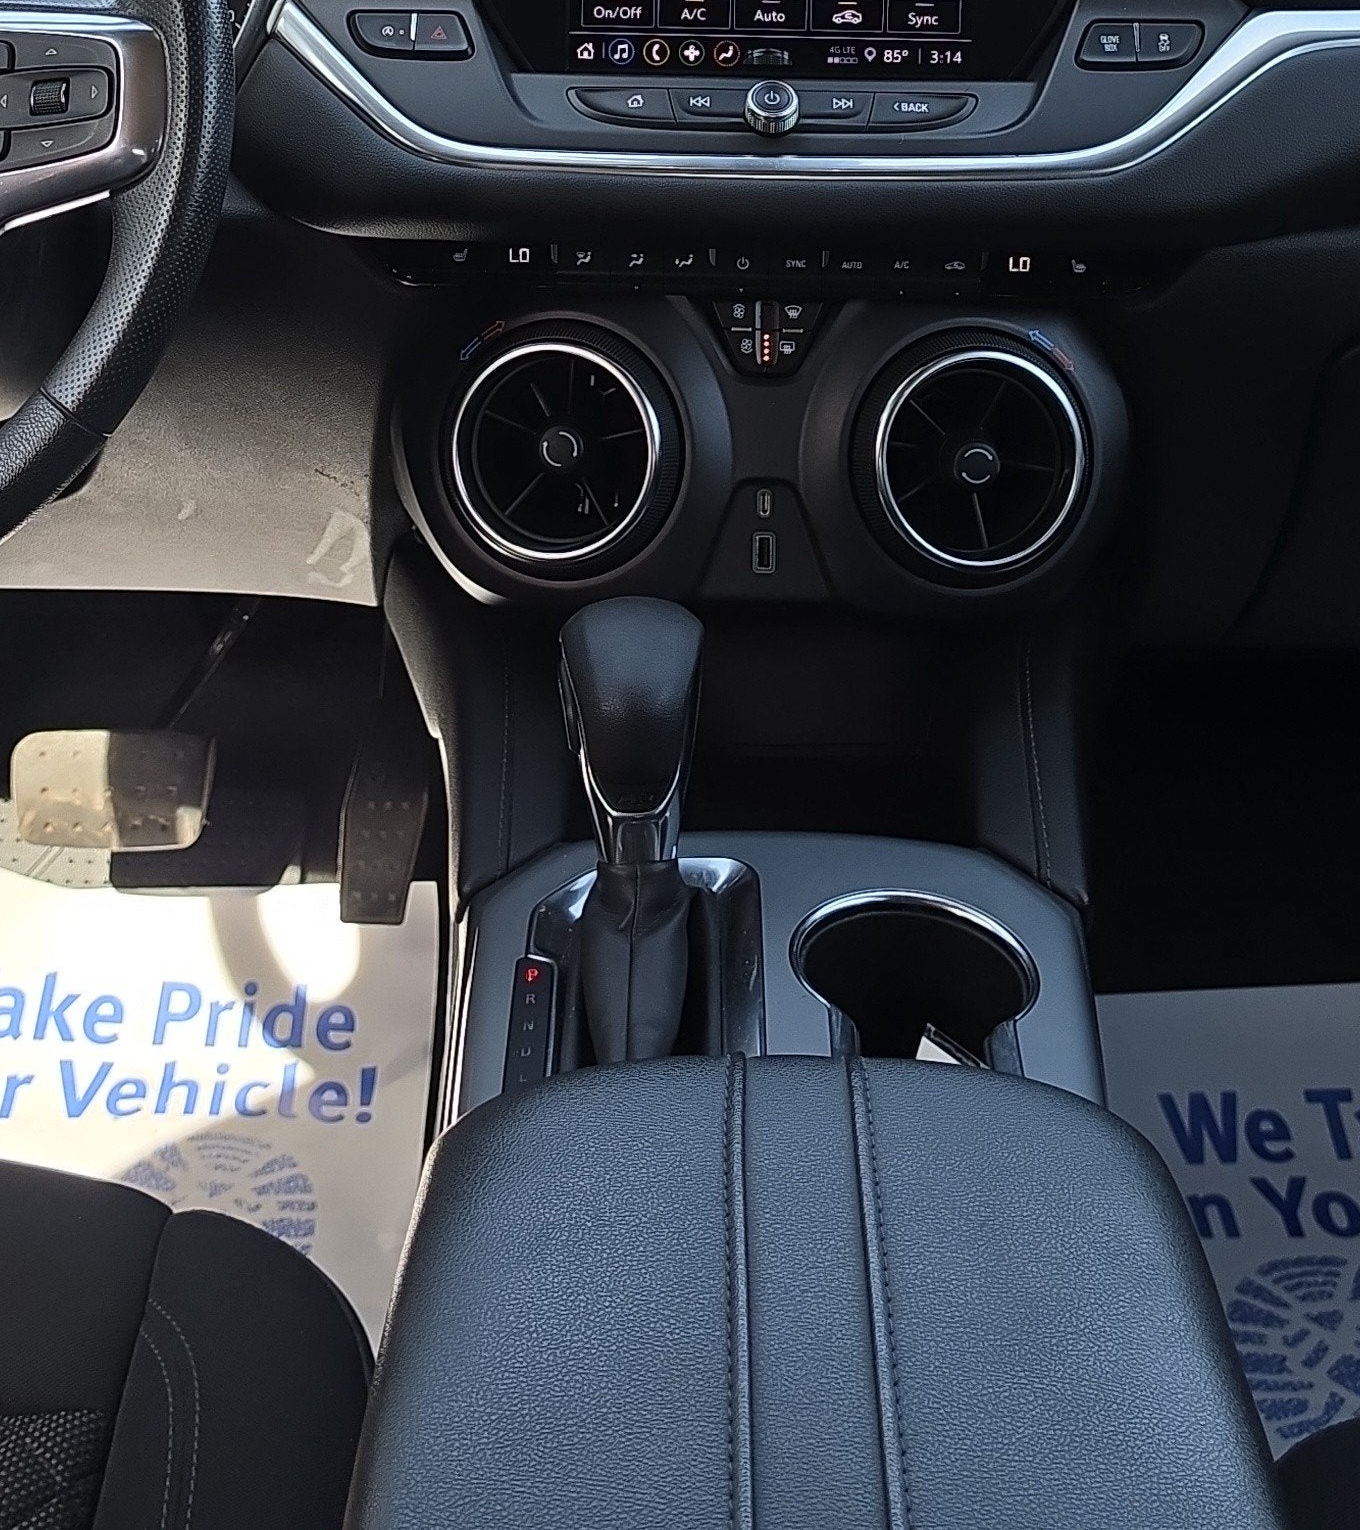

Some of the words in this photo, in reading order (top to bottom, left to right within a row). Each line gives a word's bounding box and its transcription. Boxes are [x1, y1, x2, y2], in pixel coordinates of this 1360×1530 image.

[593, 3, 642, 21] On/Off
[680, 6, 707, 22] A/C
[754, 8, 786, 23] Auto
[907, 11, 939, 28] Sync
[1100, 35, 1120, 44] GLOVE
[1104, 44, 1118, 52] BOX
[930, 50, 962, 64] 3:14
[509, 248, 530, 263] LO
[786, 259, 806, 268] SYNC
[841, 260, 863, 269] AUTO
[894, 260, 909, 270] A/C
[1009, 256, 1030, 272] LO
[527, 968, 538, 982] P
[526, 993, 536, 1004] R
[152, 979, 358, 1051] Pride
[58, 1058, 380, 1125] Vehicle!
[1157, 1091, 1293, 1166] We
[1191, 1190, 1241, 1240] n
